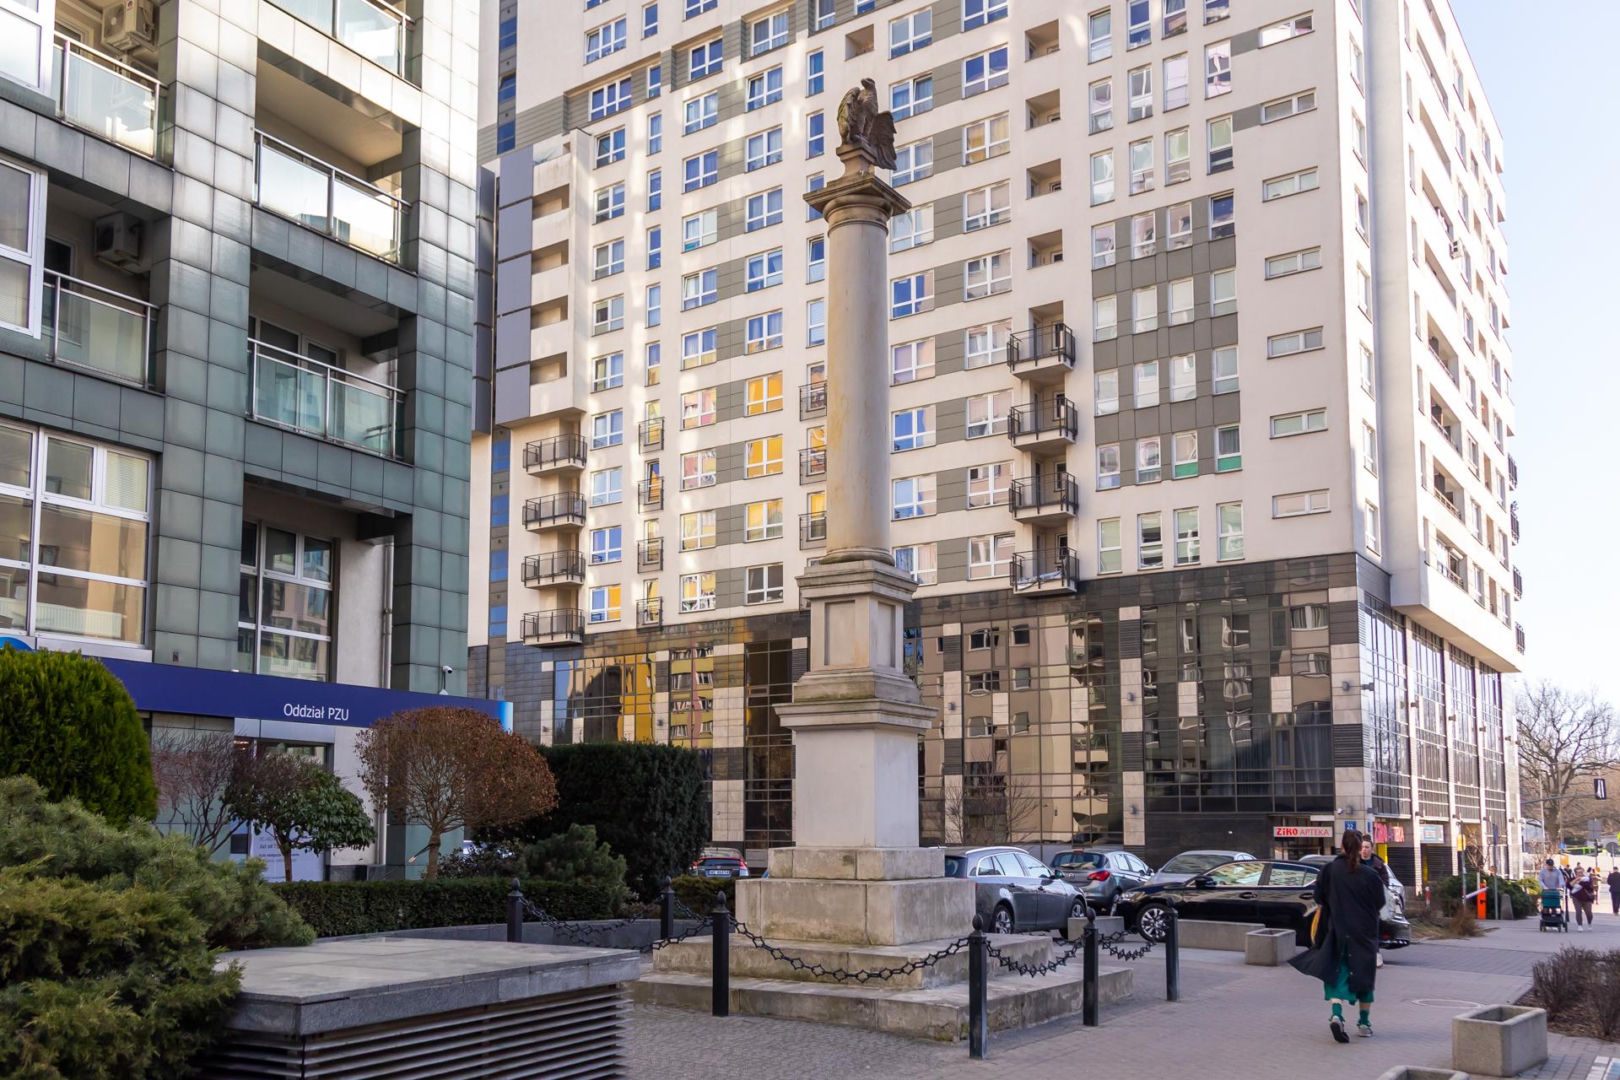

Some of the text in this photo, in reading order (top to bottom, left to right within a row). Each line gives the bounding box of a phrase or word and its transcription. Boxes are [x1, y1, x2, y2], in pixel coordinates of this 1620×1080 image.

[283, 703, 349, 721] Oddział PZU
[1300, 828, 1330, 836] APTEKA
